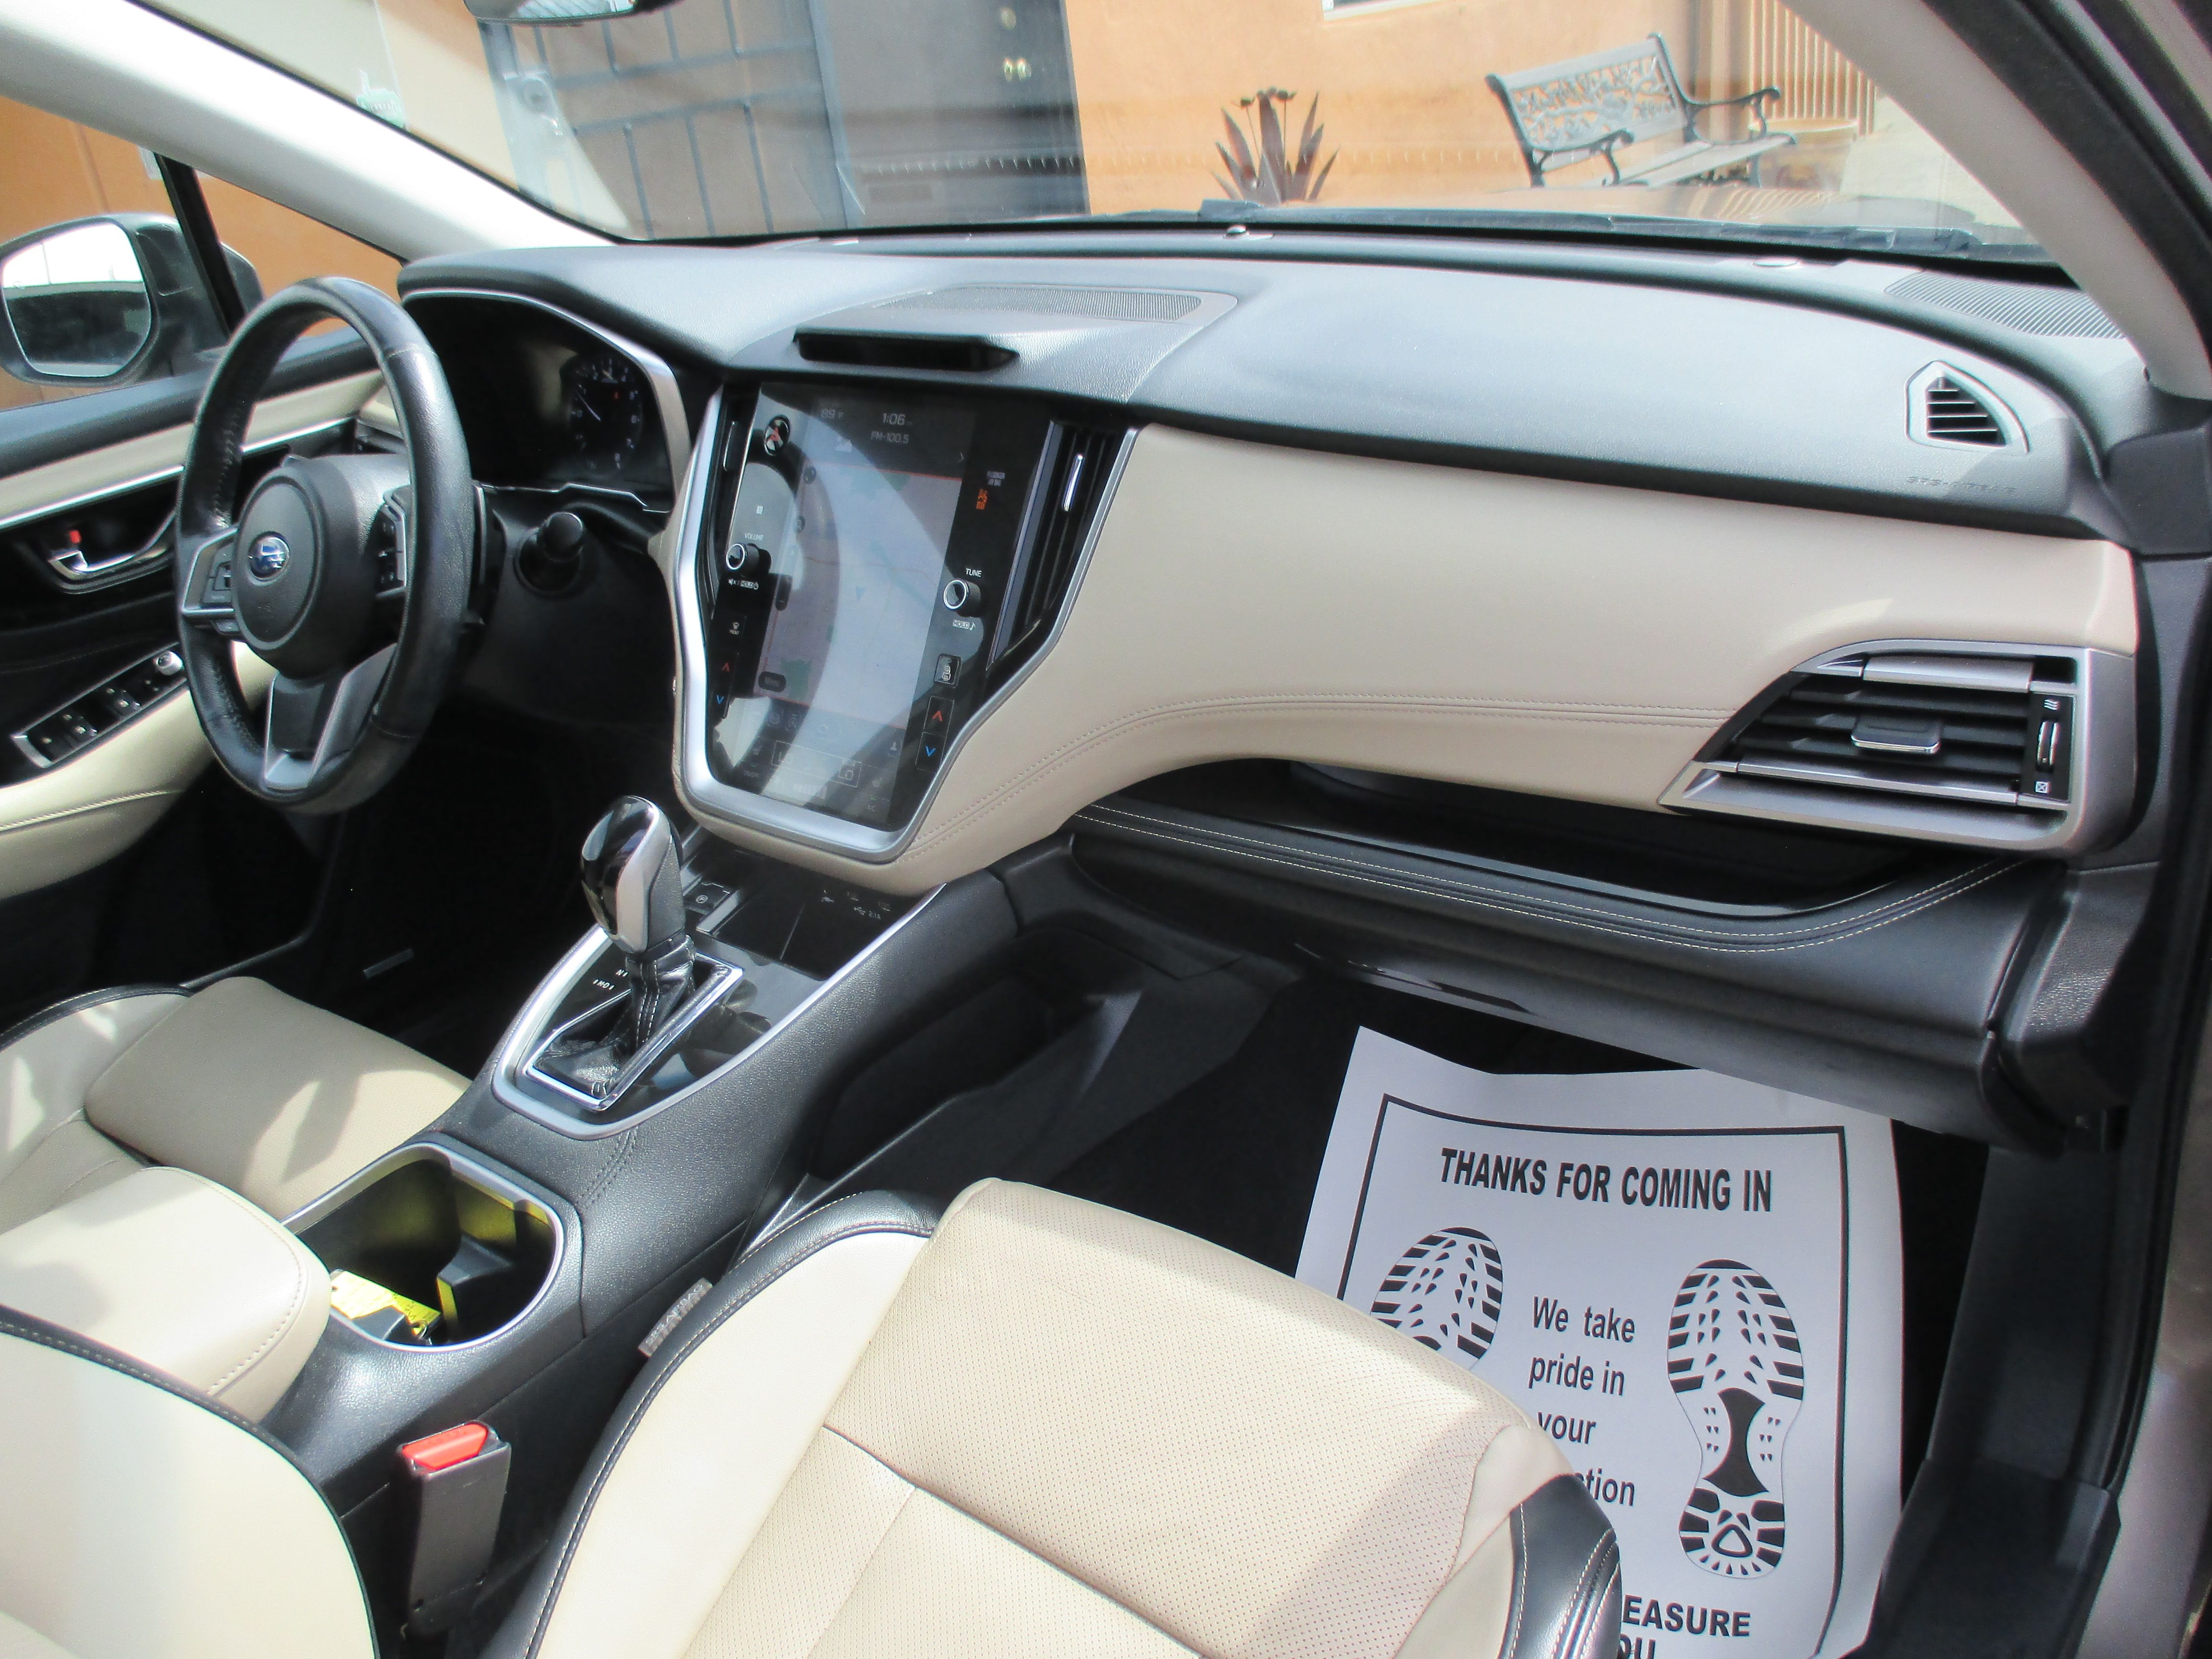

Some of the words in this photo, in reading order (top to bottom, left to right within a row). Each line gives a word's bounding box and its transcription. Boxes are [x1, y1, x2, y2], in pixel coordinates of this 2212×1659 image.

[883, 413, 905, 425] 1:06
[966, 568, 982, 577] TUNE
[953, 619, 970, 629] HOLD
[1441, 1147, 1547, 1196] THANKS
[1556, 1162, 1610, 1202] FOR
[1621, 1166, 1730, 1211] COMING
[1743, 1169, 1772, 1212] IN
[1533, 1296, 1569, 1332] We
[1584, 1306, 1635, 1343] take
[1528, 1352, 1594, 1390] pride
[1601, 1360, 1624, 1396] in
[1622, 1594, 1751, 1637] EASURE
